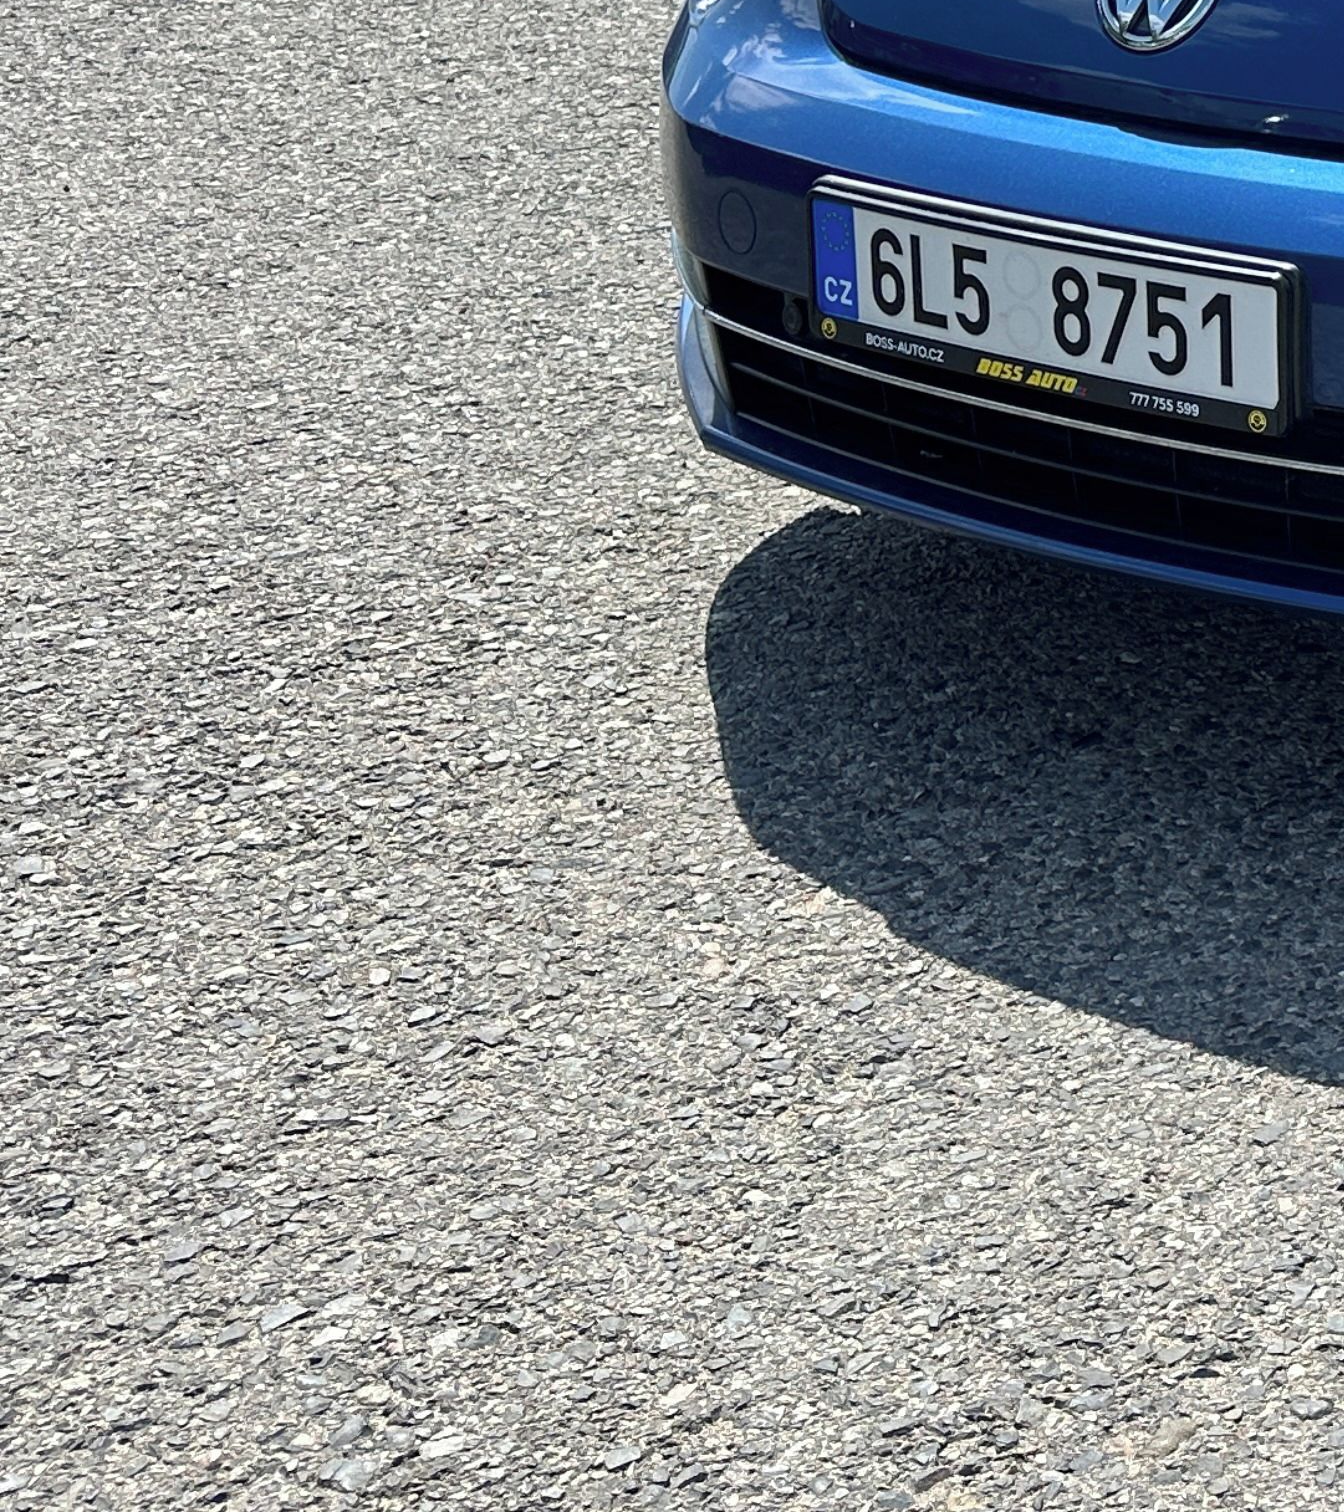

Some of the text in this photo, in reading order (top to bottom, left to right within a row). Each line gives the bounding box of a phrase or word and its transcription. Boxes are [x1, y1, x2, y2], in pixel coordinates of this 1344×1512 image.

[823, 275, 853, 307] CZ
[870, 227, 1235, 388] 6L5 8751
[865, 332, 945, 363] BOSS-AUTO.CZ
[975, 357, 1024, 383] BOSS
[1025, 368, 1079, 395] AUTO
[1128, 391, 1200, 418] 777 755 599
